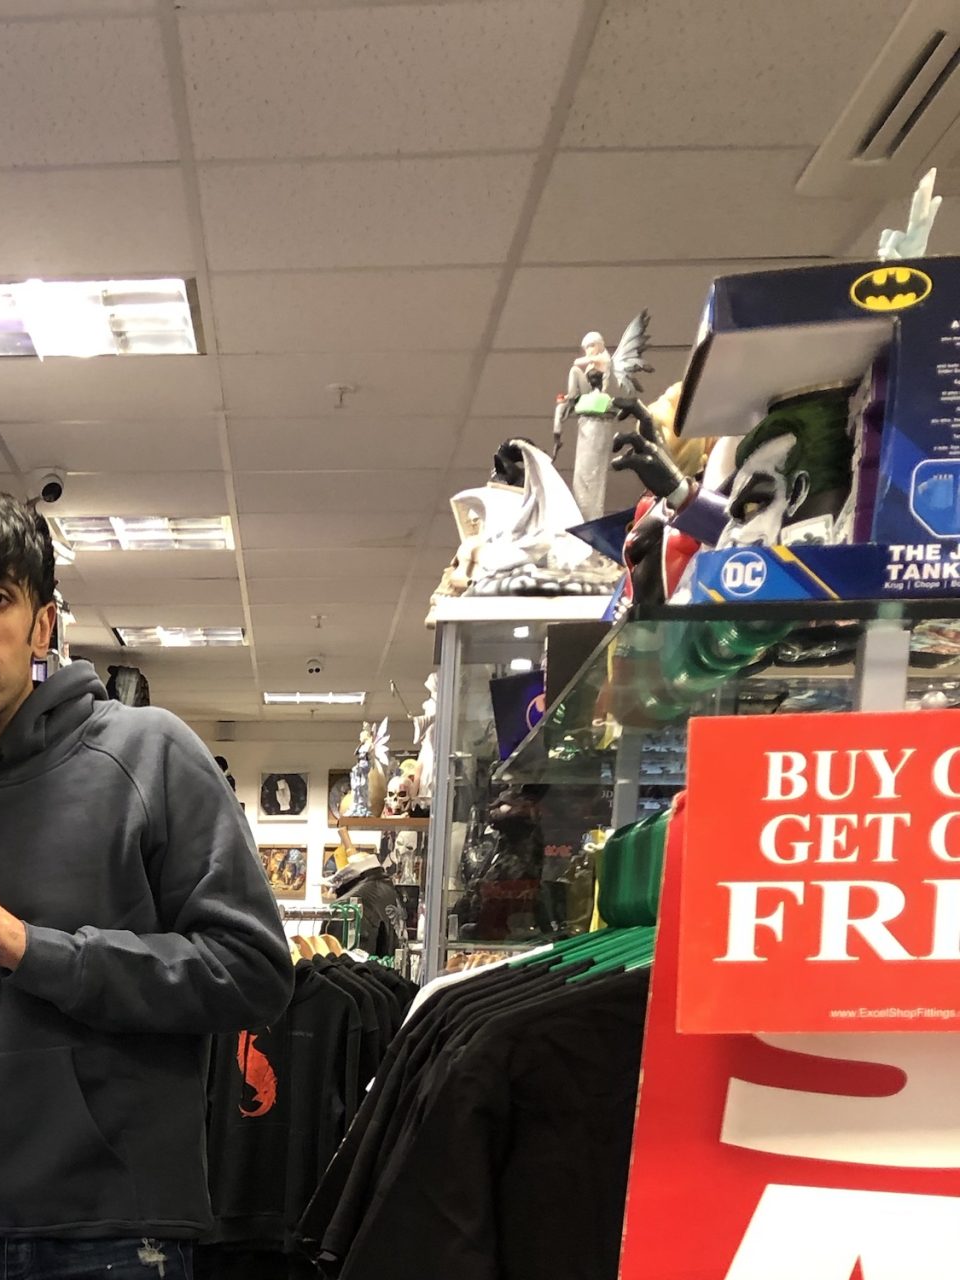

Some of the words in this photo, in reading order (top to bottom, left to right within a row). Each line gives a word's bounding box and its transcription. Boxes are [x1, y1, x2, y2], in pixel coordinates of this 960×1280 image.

[889, 545, 941, 561] THE
[726, 561, 764, 587] DC
[886, 563, 960, 581] TANK
[763, 749, 917, 801] BUY
[759, 813, 911, 864] GET
